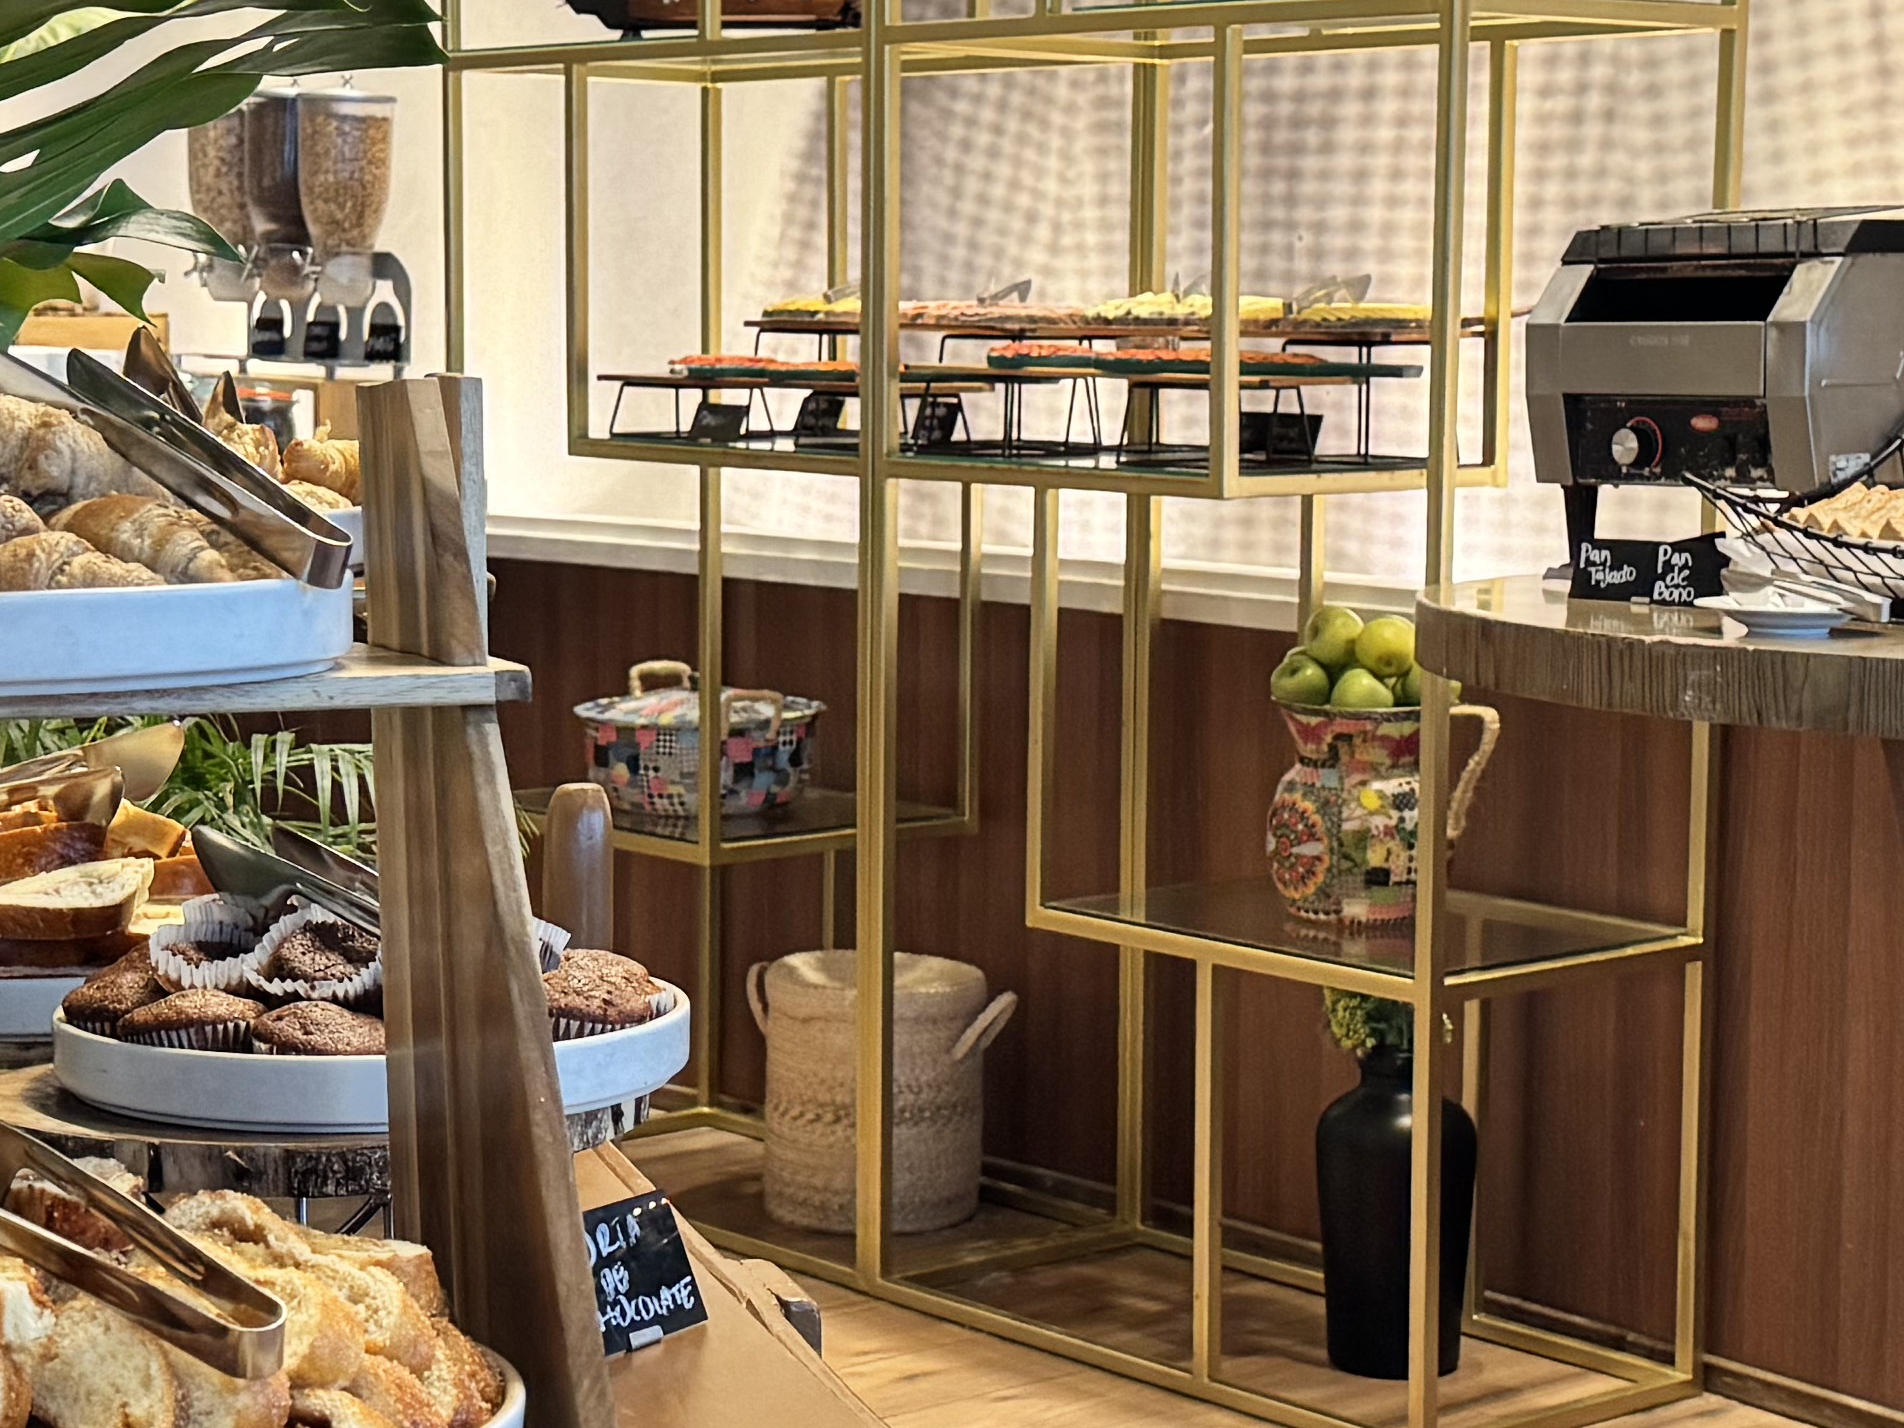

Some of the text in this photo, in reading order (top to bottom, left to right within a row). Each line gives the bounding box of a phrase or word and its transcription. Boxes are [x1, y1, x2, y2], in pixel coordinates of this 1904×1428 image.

[1579, 542, 1612, 569] Pan
[1657, 545, 1693, 574] Pan
[1587, 564, 1637, 588] Tajado
[1665, 566, 1691, 587] de
[1652, 580, 1695, 604] Bono
[598, 1275, 695, 1333] HOCOLATE
